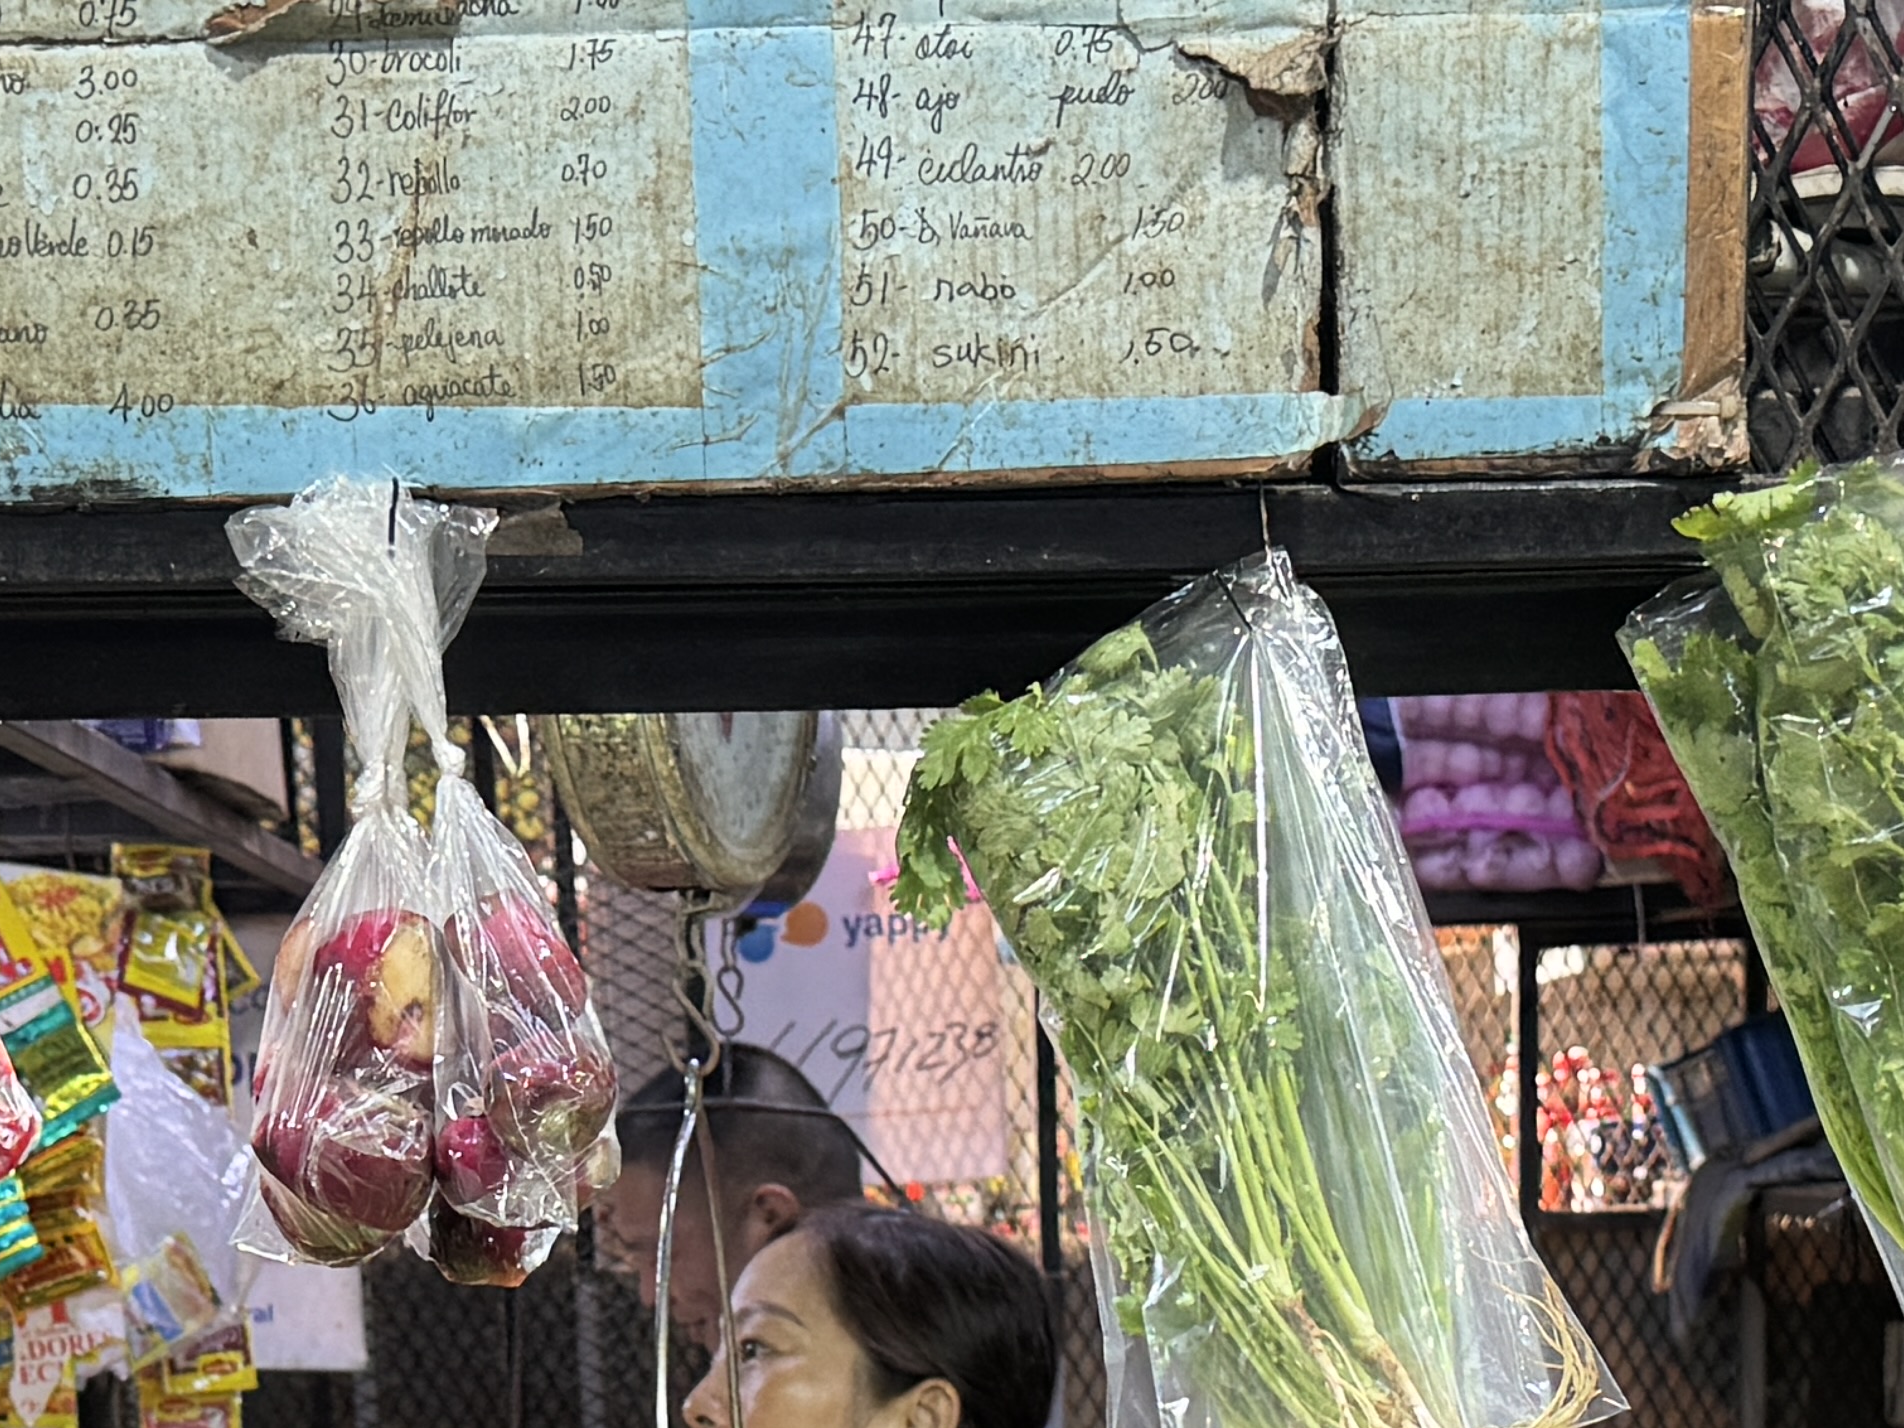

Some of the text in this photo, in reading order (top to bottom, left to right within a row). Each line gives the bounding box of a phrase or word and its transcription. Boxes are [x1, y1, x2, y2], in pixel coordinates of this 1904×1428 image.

[568, 39, 617, 71] 1.75
[1054, 27, 1114, 63] 0.75
[75, 65, 138, 99] 3.00
[560, 95, 612, 122] 2.00
[73, 167, 139, 204] 0.35
[561, 153, 608, 187] 0.70
[107, 226, 157, 258] 0.15
[1122, 267, 1177, 297] 1.00
[95, 299, 161, 332] 0.35
[108, 383, 175, 423] 4.00
